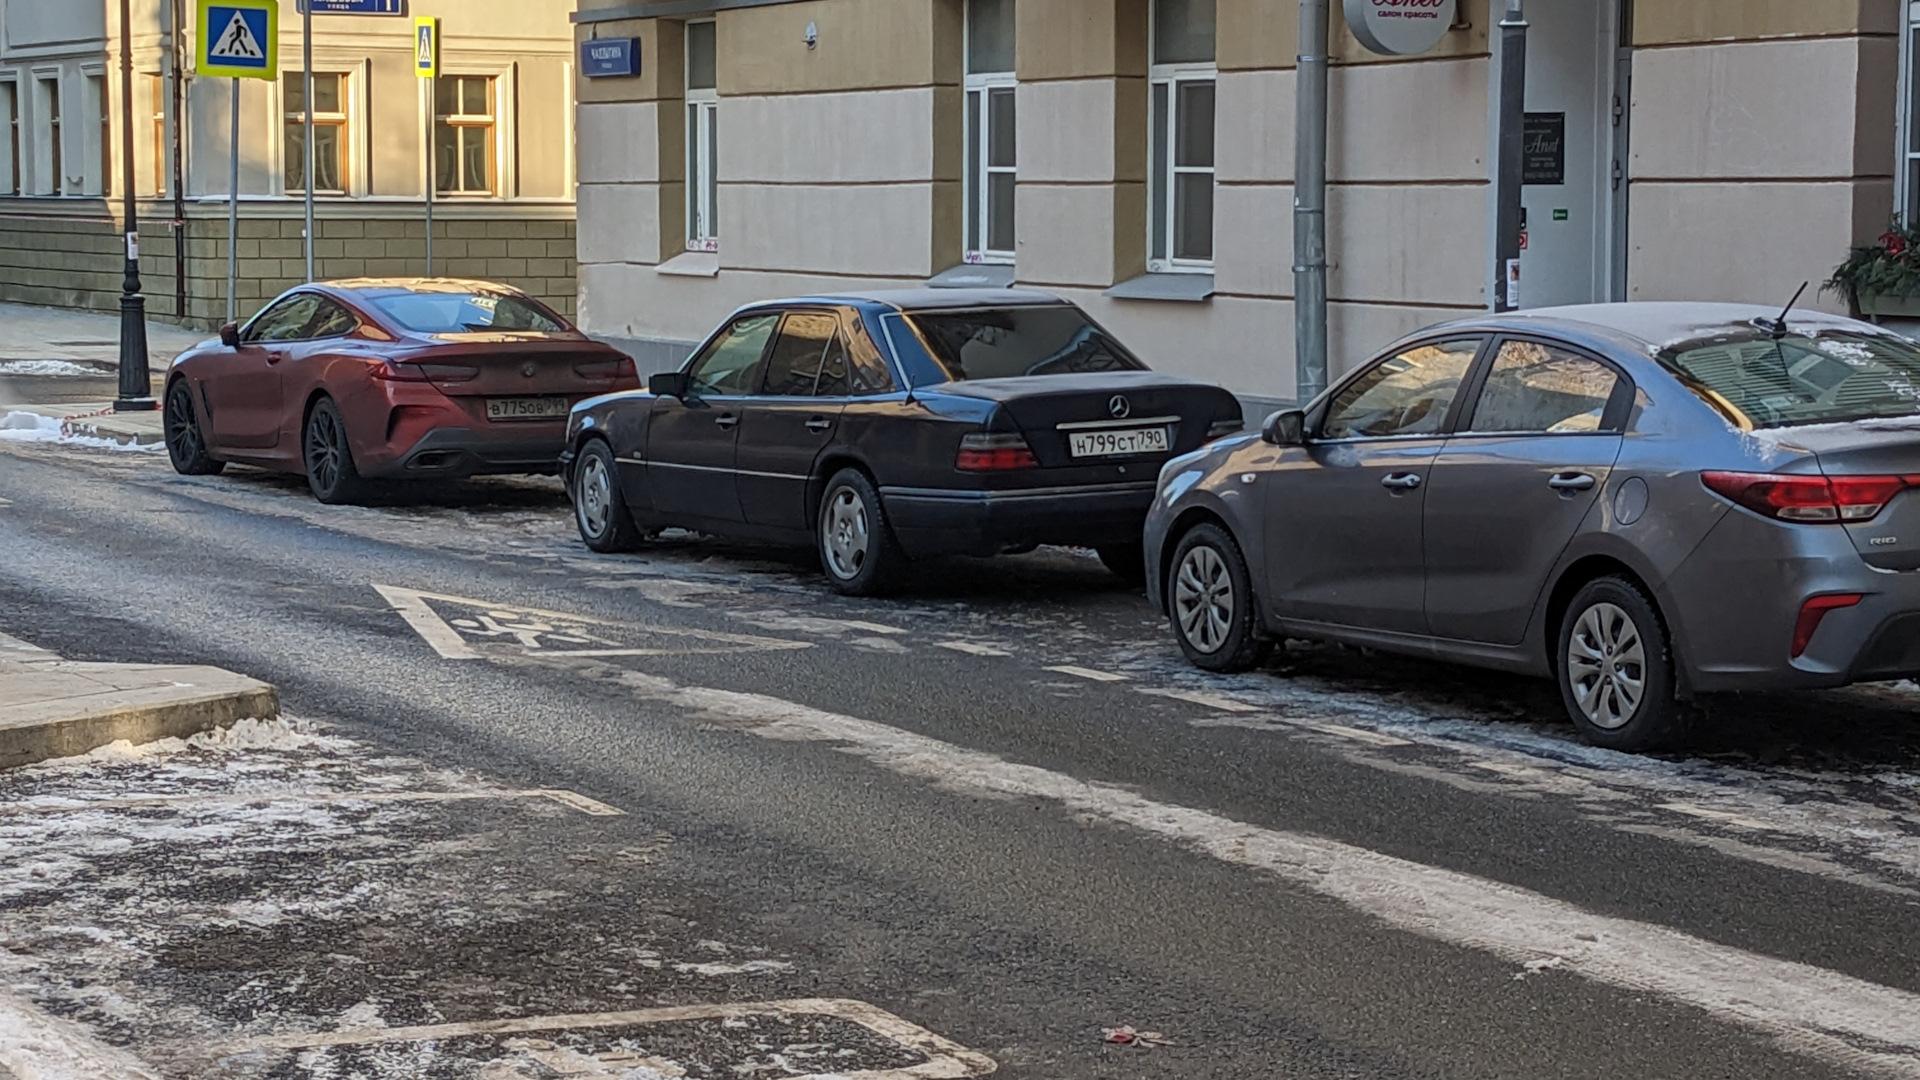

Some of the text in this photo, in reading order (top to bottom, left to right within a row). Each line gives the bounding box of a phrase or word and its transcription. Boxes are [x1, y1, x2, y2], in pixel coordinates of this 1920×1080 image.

[1377, 10, 1438, 19] салон красоты
[1870, 536, 1897, 545] RIO
